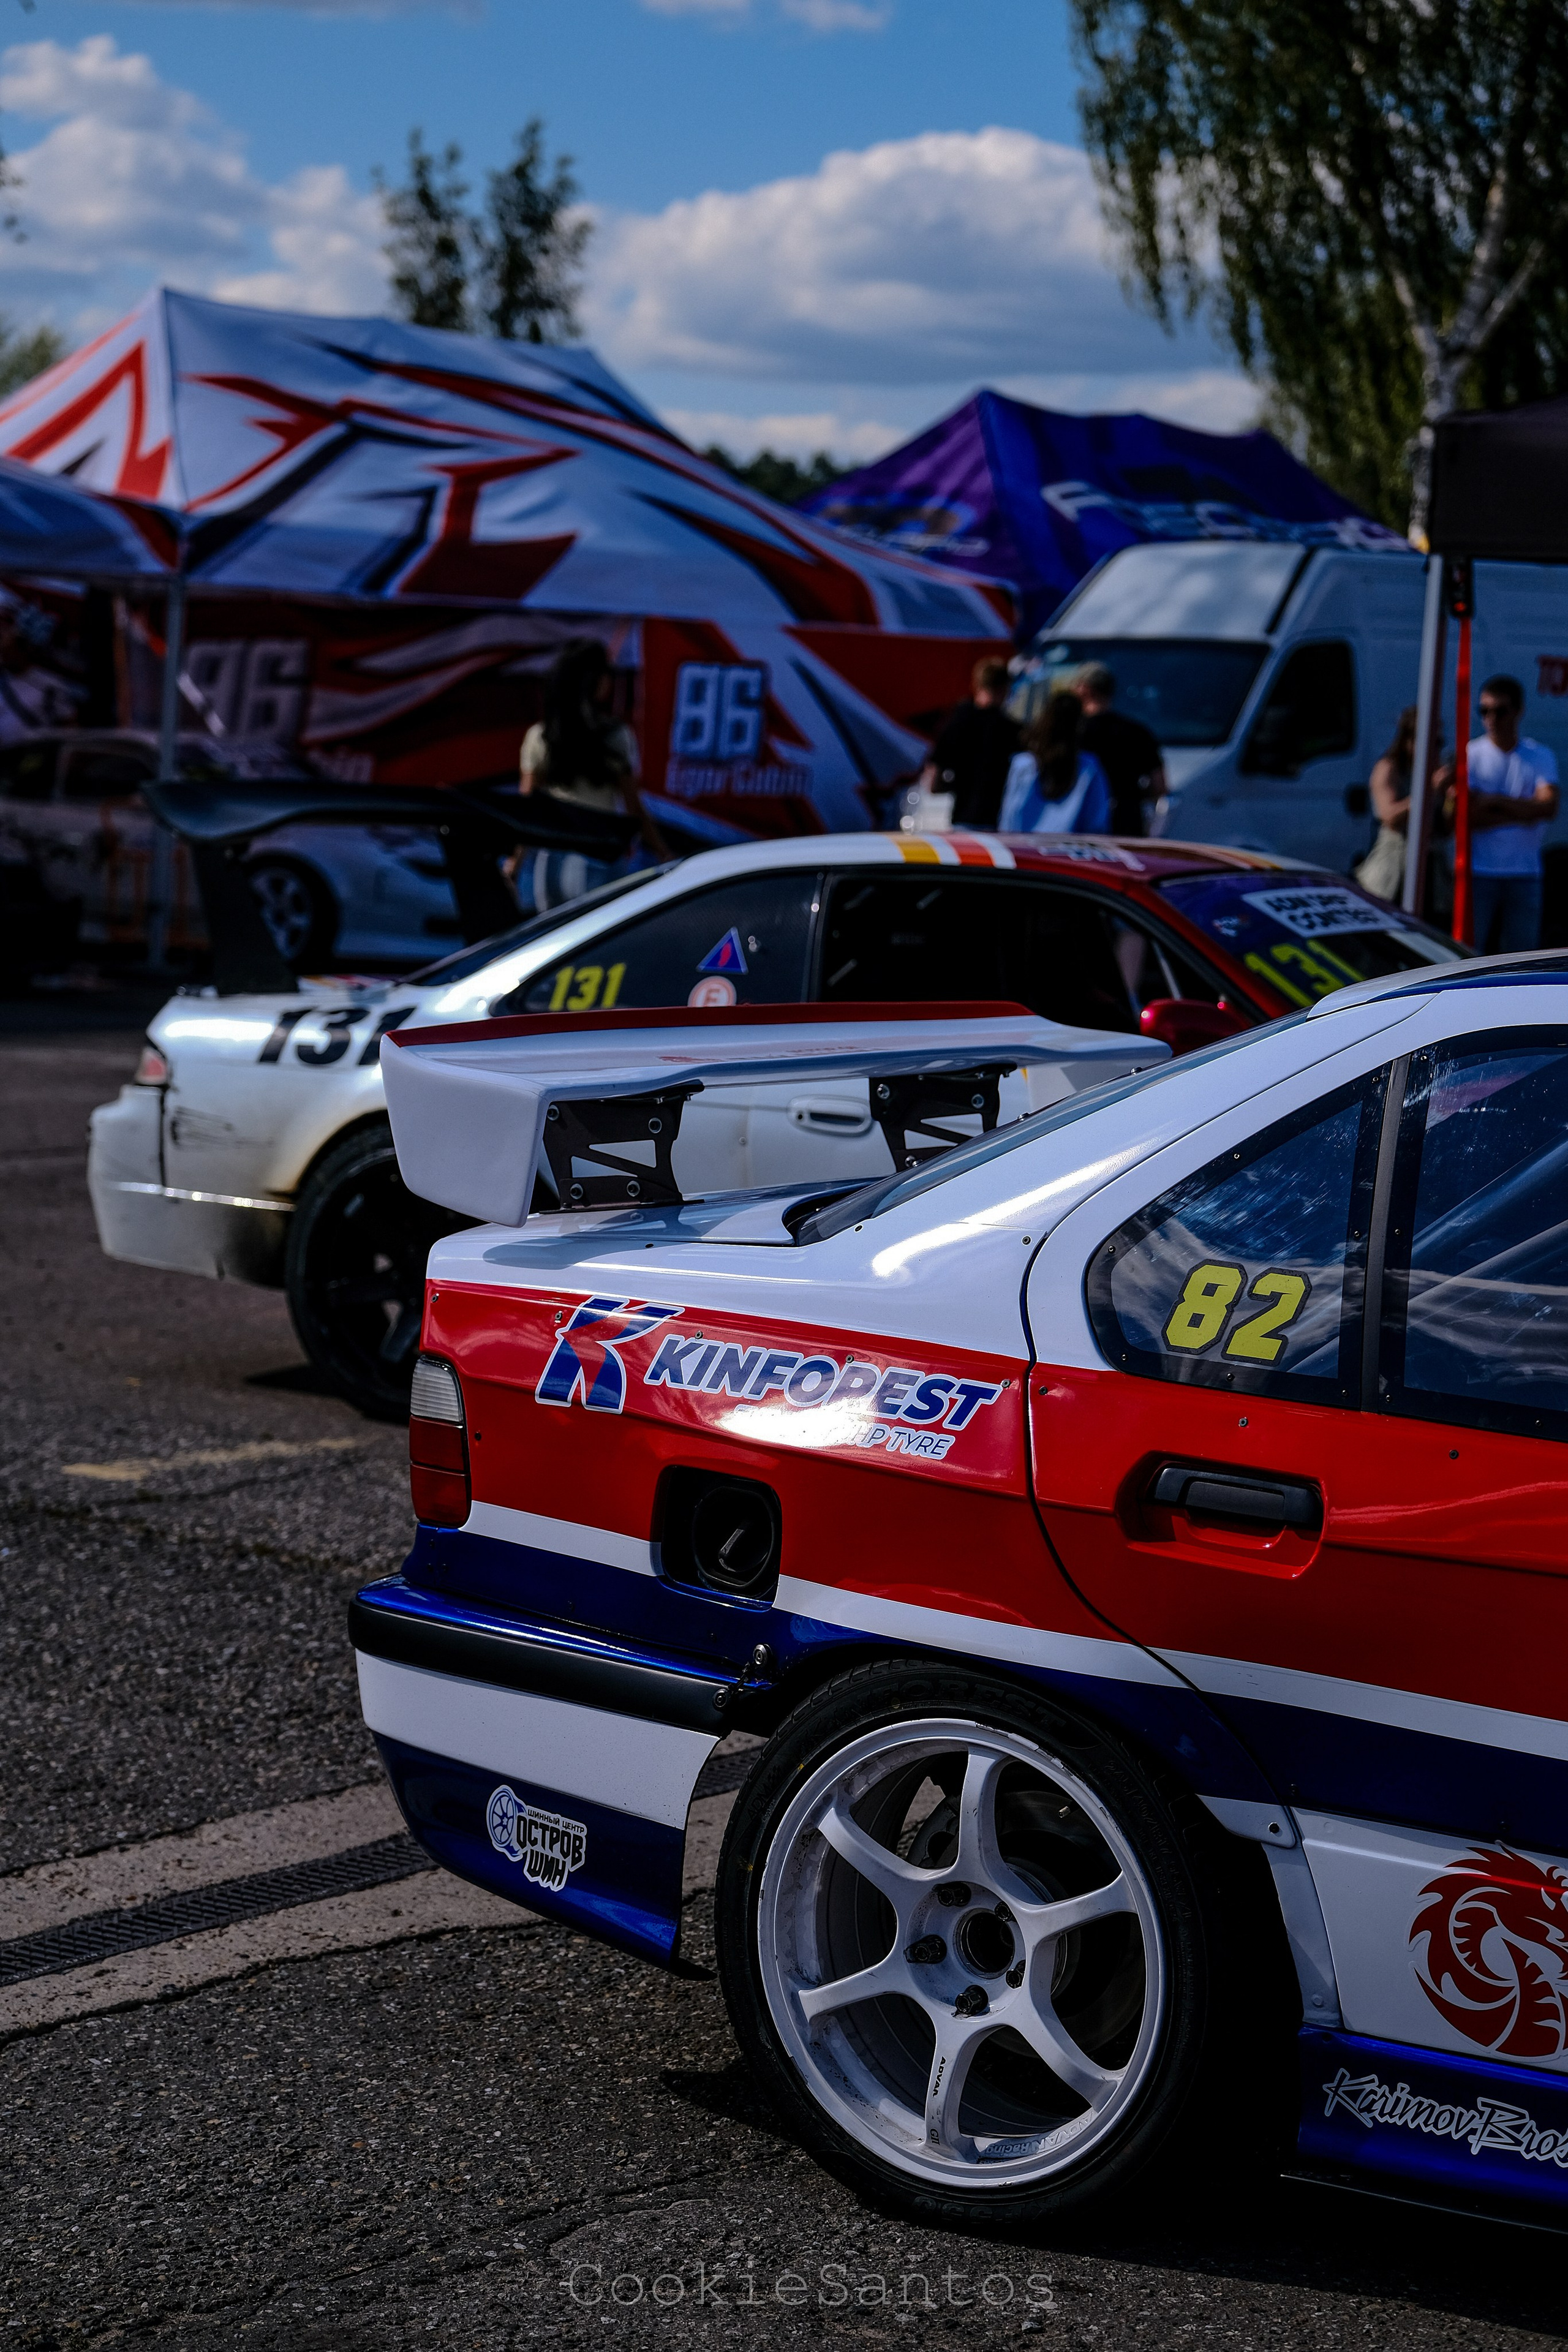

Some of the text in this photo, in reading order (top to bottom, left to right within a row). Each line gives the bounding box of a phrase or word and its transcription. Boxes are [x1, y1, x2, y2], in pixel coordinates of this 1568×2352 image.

[676, 663, 764, 760] 86
[549, 962, 627, 1012] 131
[1243, 938, 1365, 1009] 131
[257, 1007, 417, 1065] 131
[1164, 1261, 1310, 1364] 82
[646, 1336, 1001, 1428] KINFOREST
[888, 1429, 952, 1457] TYRE
[516, 1815, 584, 1868] ОСТРОВ
[528, 1809, 584, 1834] ШИННЫЙ ЦЕНТР
[527, 1849, 566, 1888] ШИН
